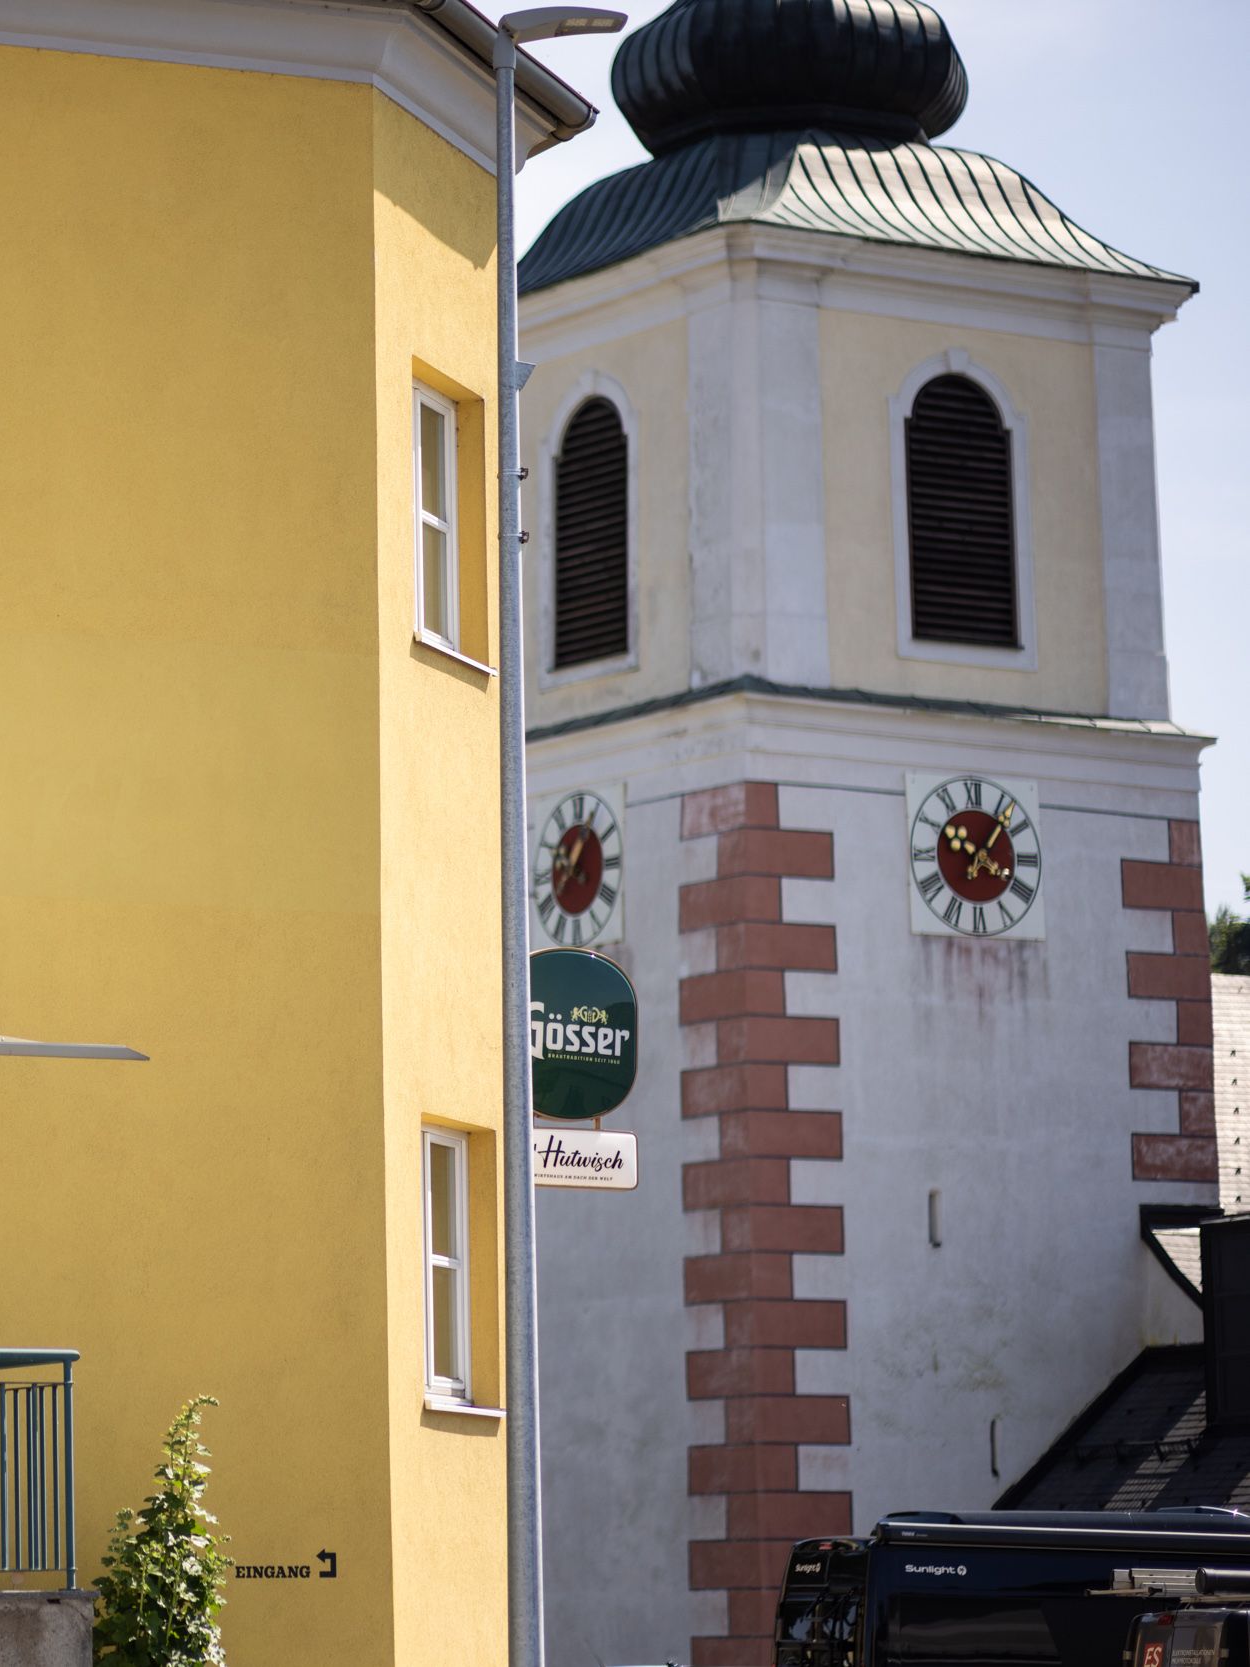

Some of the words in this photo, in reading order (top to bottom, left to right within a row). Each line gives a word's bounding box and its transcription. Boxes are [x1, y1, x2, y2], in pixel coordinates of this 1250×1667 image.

[530, 1001, 630, 1060] Gösser
[235, 1565, 311, 1579] EINGANG
[905, 1564, 956, 1576] Sunlight
